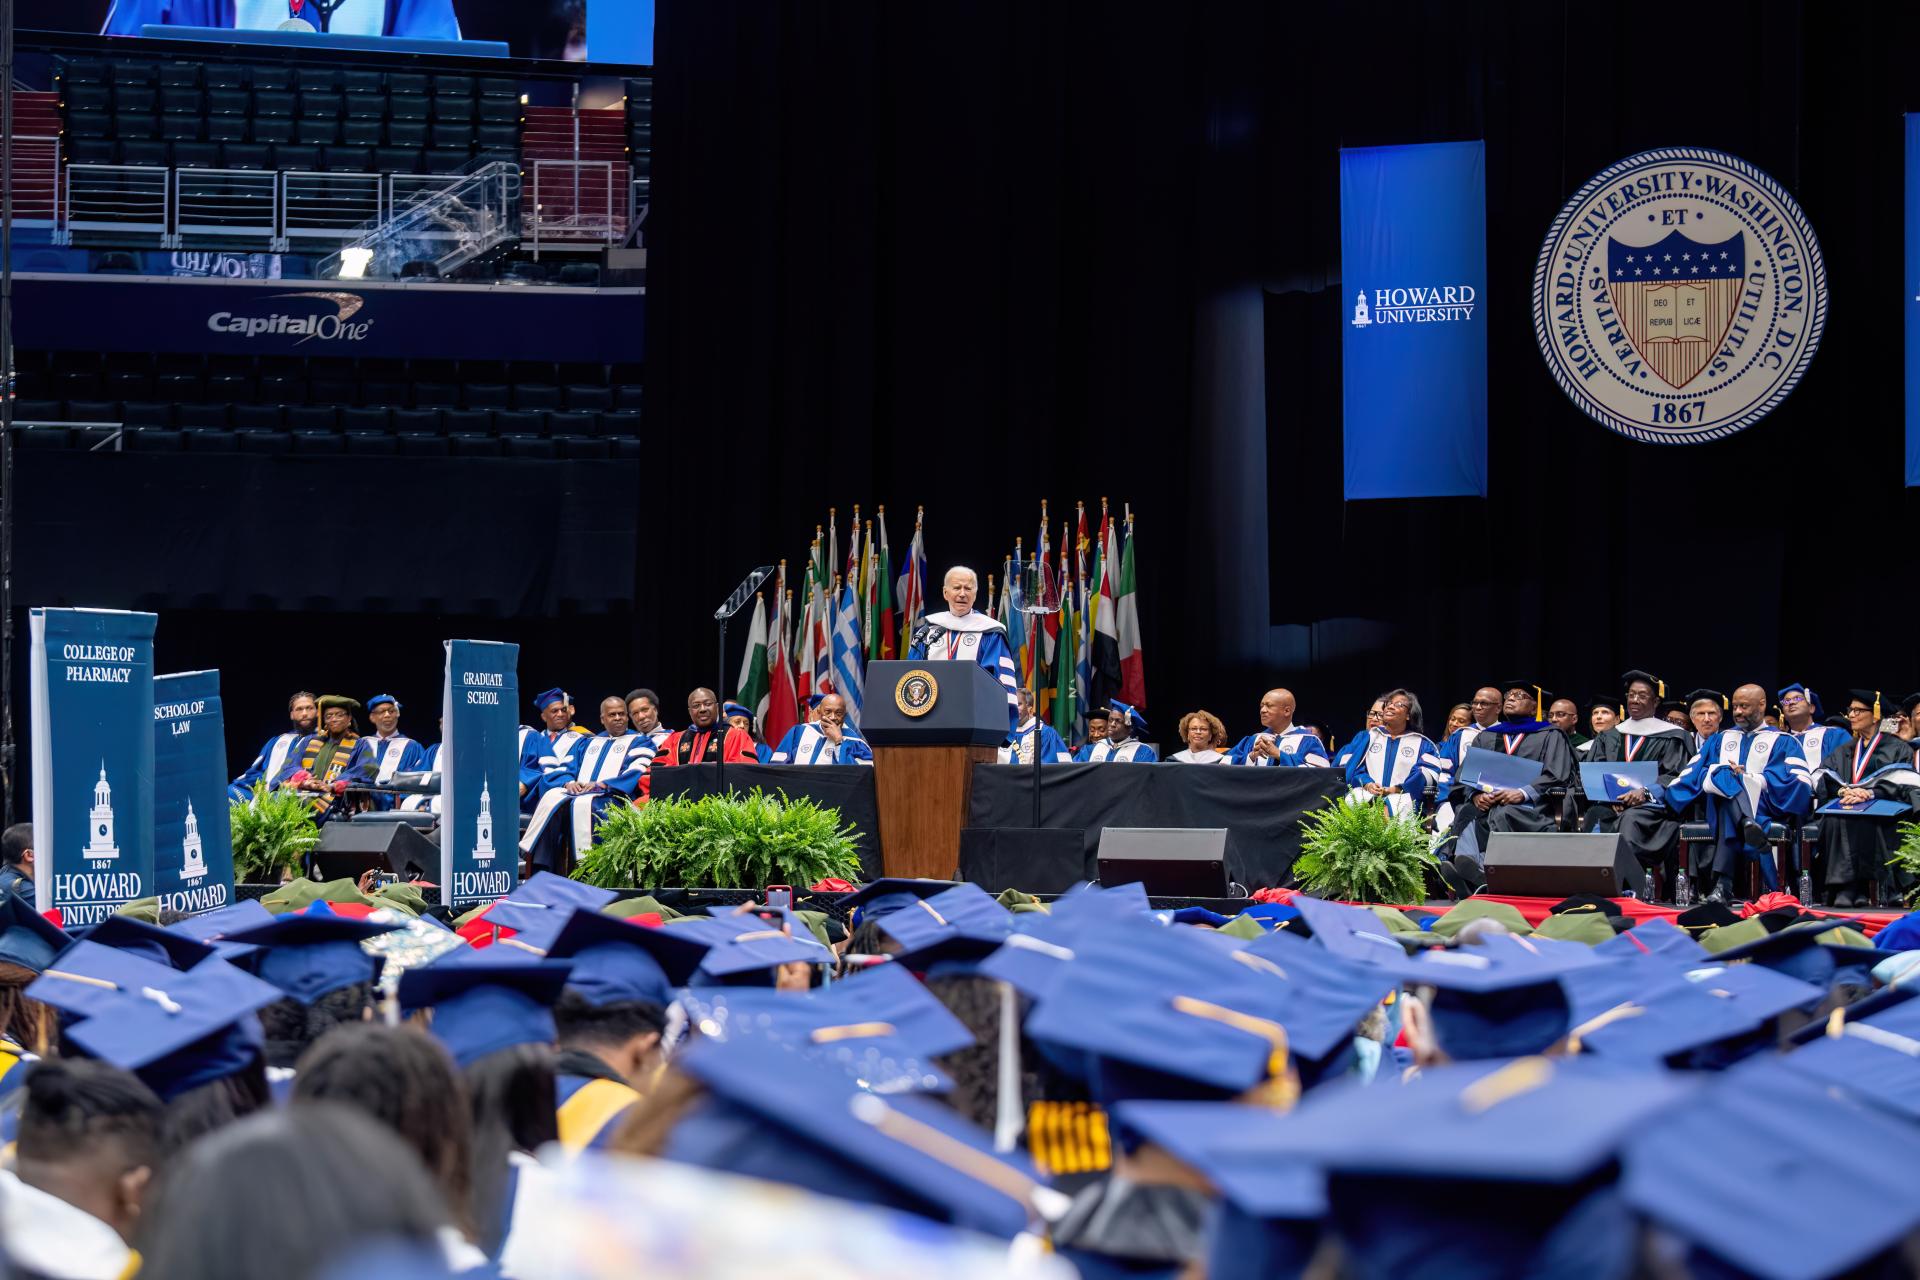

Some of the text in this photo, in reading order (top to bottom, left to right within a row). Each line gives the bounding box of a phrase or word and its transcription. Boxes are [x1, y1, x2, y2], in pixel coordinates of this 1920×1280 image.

[1563, 171, 1695, 263] UNIVERSITY
[1661, 208, 1688, 226] ET
[1375, 285, 1476, 307] HOWARD
[1653, 298, 1696, 307] DEO ET
[1375, 307, 1474, 324] UNIVERSITY
[1649, 318, 1673, 326] REIPUB
[1712, 271, 1766, 373] UTILITAS
[1556, 271, 1601, 382] HOWARD
[1589, 276, 1641, 376] VERITAS
[1758, 326, 1796, 371] D.C.
[1651, 401, 1706, 423] 1867
[63, 644, 136, 662] COLLEGE OF
[66, 666, 132, 683] PHARMACY
[463, 671, 503, 687] GRADUATE
[467, 690, 499, 705] SCHOOL
[154, 701, 205, 719] SCHOOL OF
[171, 720, 191, 735] LAW
[92, 859, 112, 870] 1867
[478, 859, 491, 869] 1867
[55, 872, 142, 901] HOWARD
[187, 876, 203, 888] 1867
[453, 870, 511, 895] HOWARD
[157, 883, 227, 914] HOWARD
